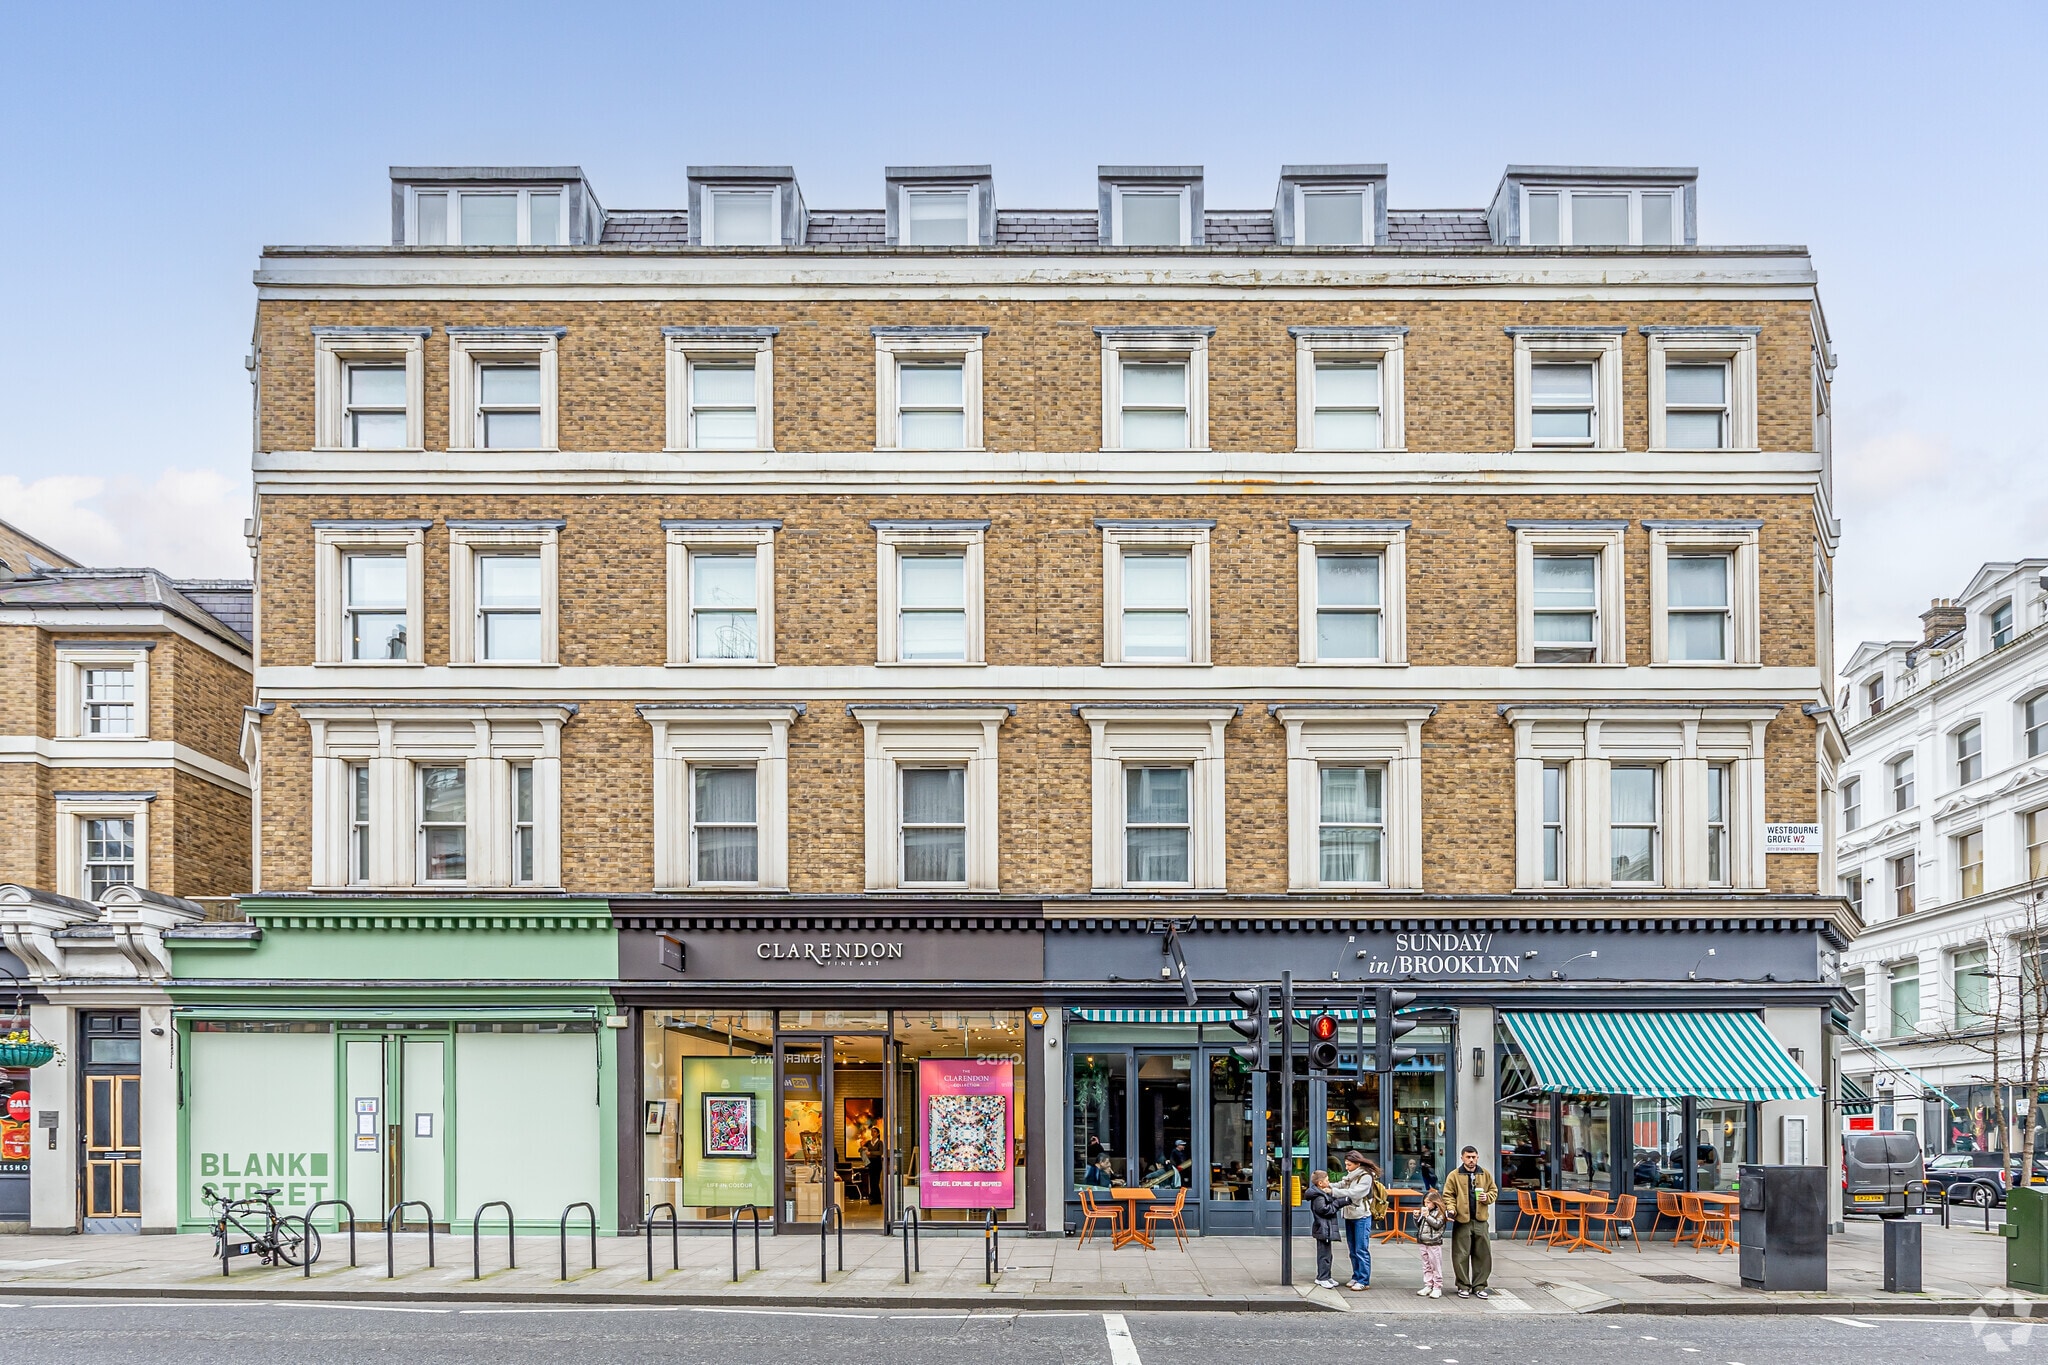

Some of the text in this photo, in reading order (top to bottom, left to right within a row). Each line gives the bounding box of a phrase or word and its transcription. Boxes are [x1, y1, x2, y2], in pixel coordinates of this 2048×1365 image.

[1767, 826, 1818, 834] WESTBOURNE
[1767, 835, 1805, 843] GROVE W2
[757, 942, 903, 966] CLARENDON
[201, 1153, 307, 1176] BLANK
[201, 1182, 328, 1206] STREET
